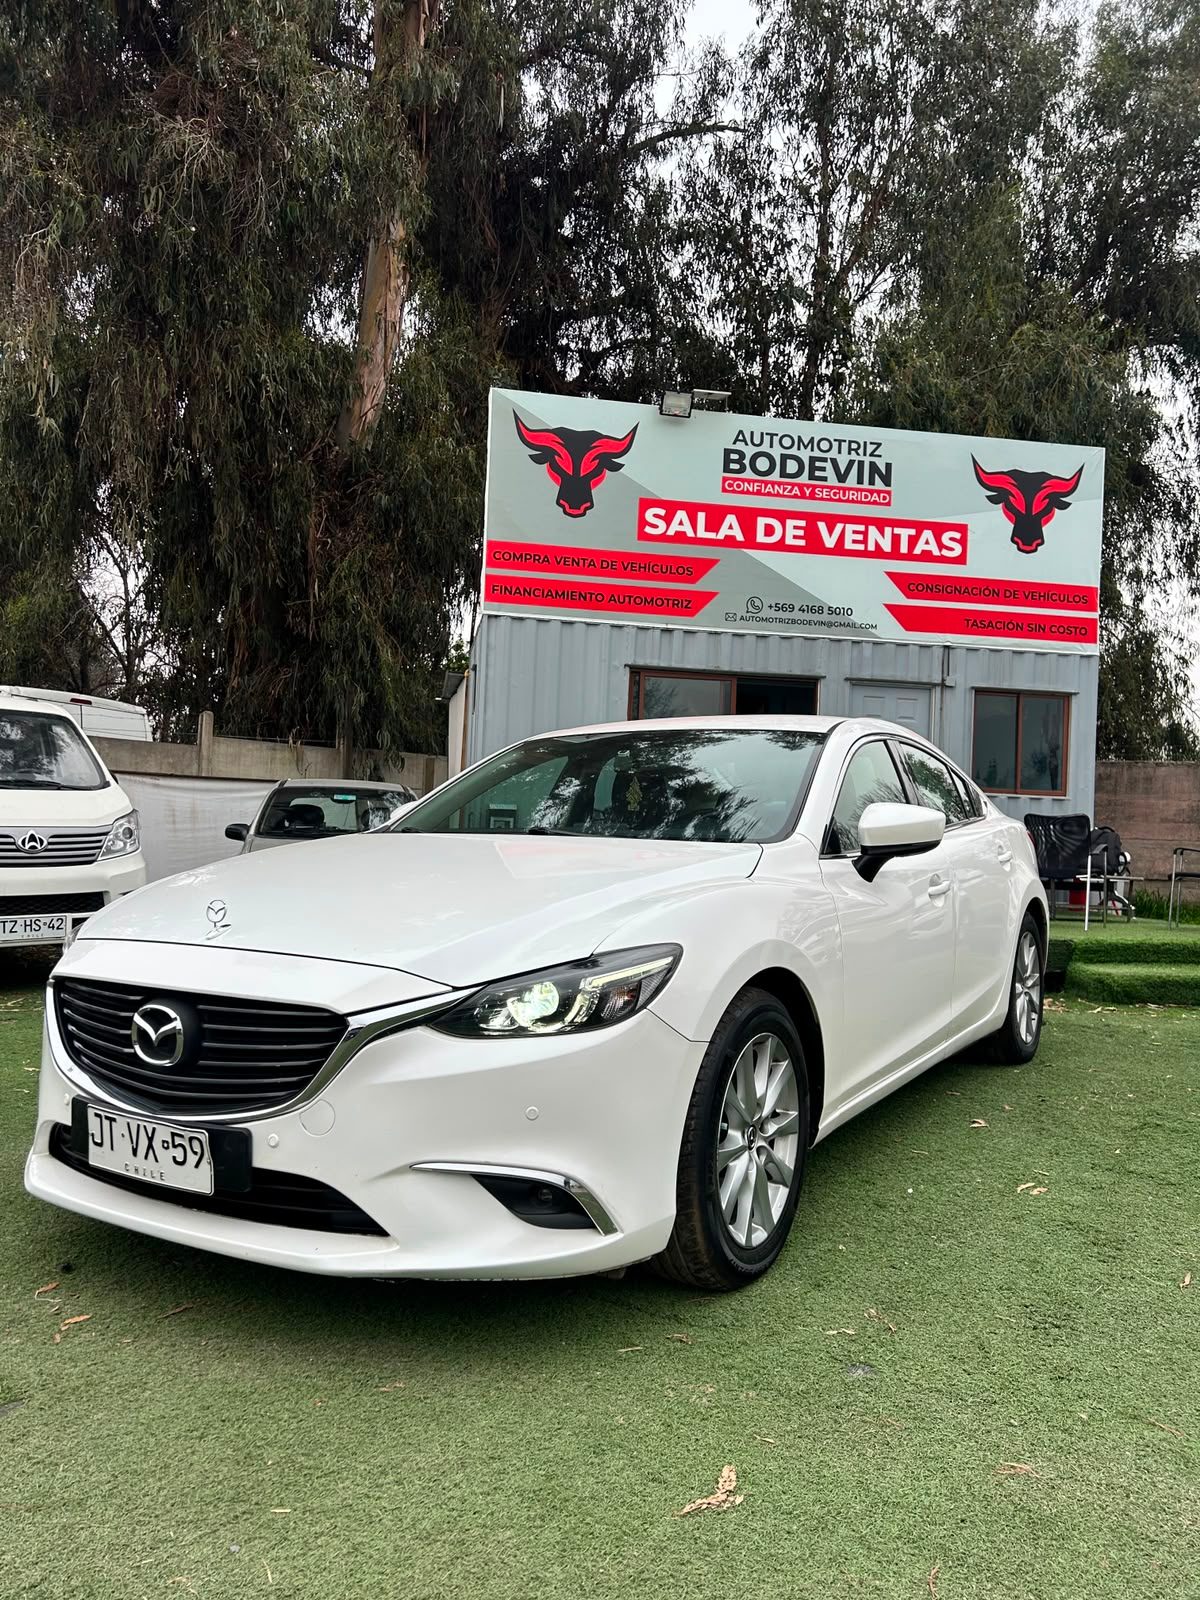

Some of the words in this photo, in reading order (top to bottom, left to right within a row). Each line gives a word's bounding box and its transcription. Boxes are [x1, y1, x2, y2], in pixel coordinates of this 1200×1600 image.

[732, 429, 883, 458] AUTOMOTRIZ
[722, 447, 893, 487] BODEVIN
[724, 479, 801, 497] CONFIANZA
[804, 486, 813, 497] Y
[815, 487, 890, 503] SEGURIDAD
[643, 507, 745, 542] SALA
[756, 516, 806, 546] DE
[817, 521, 963, 558] VENTAS
[492, 550, 551, 566] COMPRA
[554, 555, 597, 569] VENTA
[600, 559, 618, 571] DE
[621, 561, 694, 577] VEHÍCULOS
[491, 584, 605, 603] FINANCIAMIENTO
[607, 593, 692, 610] AUTOMOTRIZ
[907, 582, 1000, 598] CONSIGNACIÓN
[1004, 588, 1019, 599] DE
[1022, 590, 1089, 605] VEHÍCULOS
[767, 602, 795, 613] +569
[798, 604, 824, 615] 4168
[827, 606, 853, 617] 5010
[739, 615, 878, 630] AUTOMOTRIZBODEVIN@GMAIL.COM
[964, 618, 1024, 632] TASACIÓN
[1027, 623, 1046, 633] SIN
[1049, 624, 1088, 637] COSTO
[124, 1162, 165, 1181] CHILE
